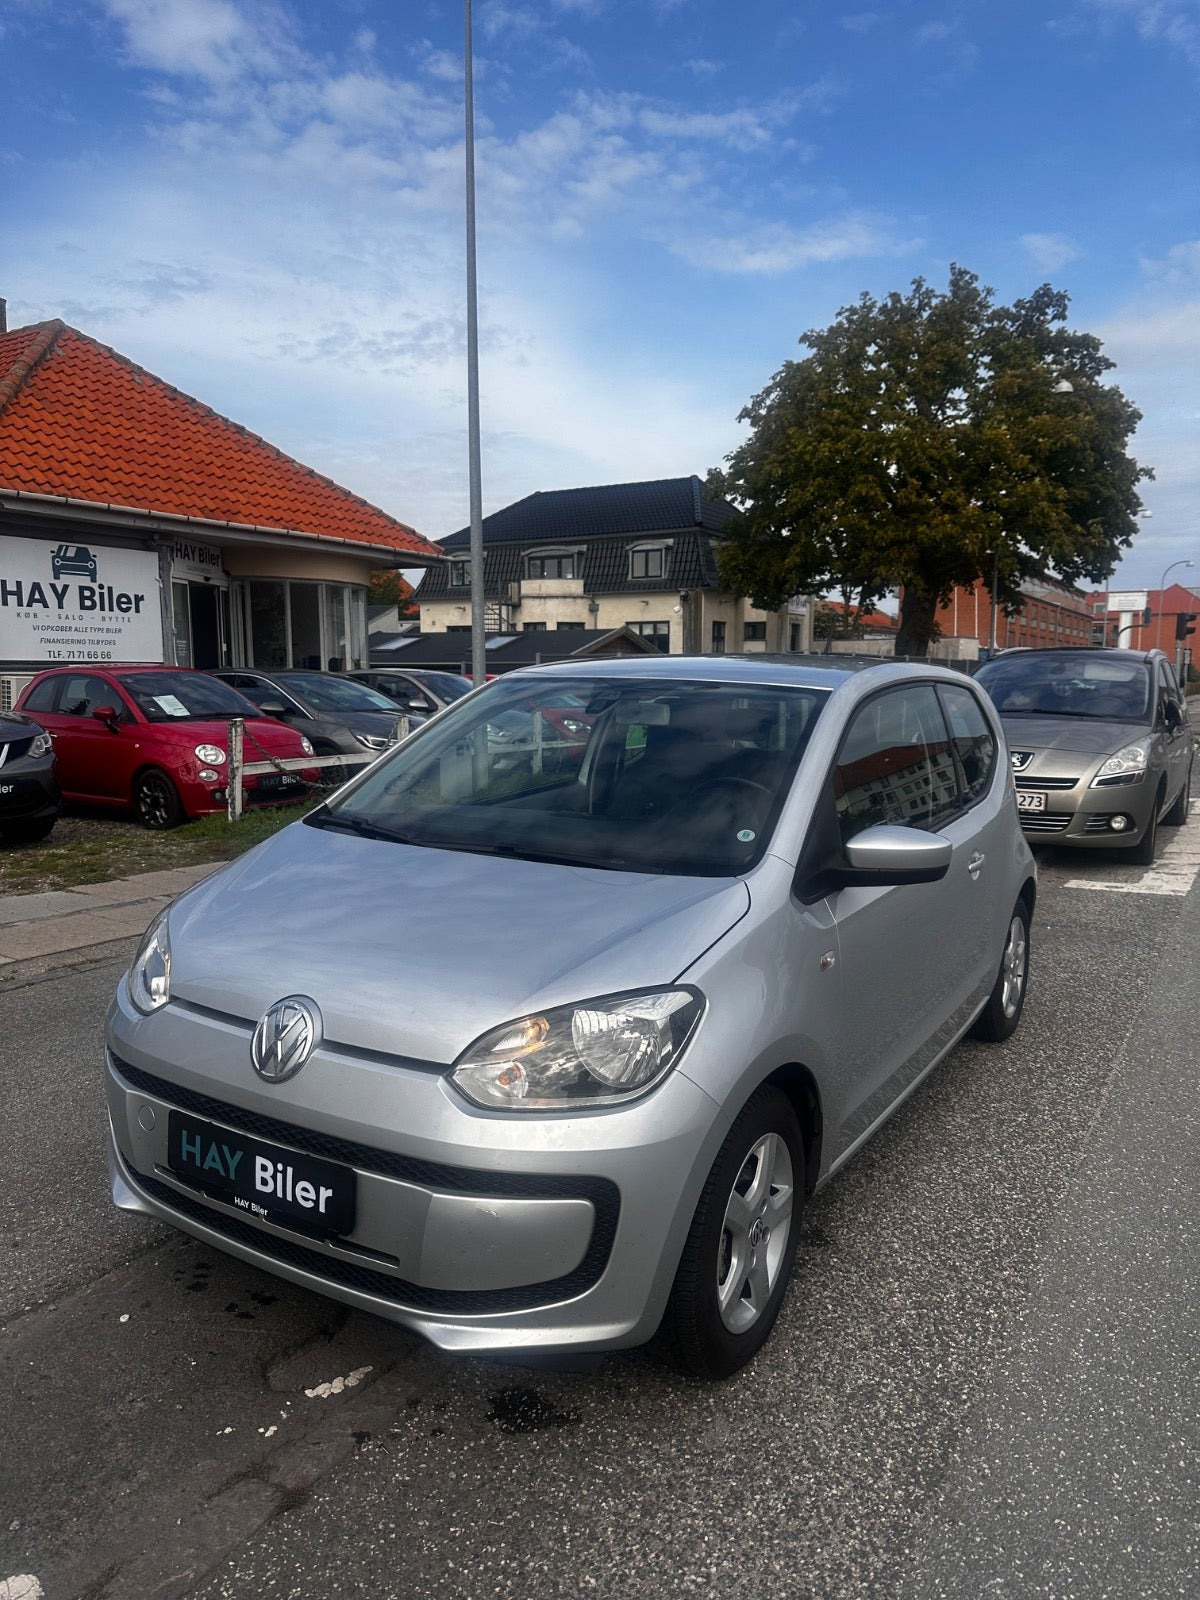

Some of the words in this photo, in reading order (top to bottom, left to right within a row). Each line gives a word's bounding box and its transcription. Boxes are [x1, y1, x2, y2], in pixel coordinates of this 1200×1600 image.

[175, 542, 196, 561] HAY
[198, 547, 220, 567] Biler
[1, 579, 70, 609] HAY
[78, 583, 145, 614] Biler
[101, 615, 132, 623] BYTTE
[32, 624, 40, 632] VI
[40, 637, 87, 645] FINANSIERING
[87, 638, 117, 646] TILBYDES
[47, 650, 65, 659] TLF.
[66, 650, 75, 659] 71
[77, 651, 85, 659] 71
[87, 651, 99, 659] 66
[100, 651, 112, 659] 66
[1018, 795, 1043, 808] 273
[181, 1129, 244, 1181] HAY
[255, 1155, 333, 1214] Biler
[234, 1196, 250, 1209] HAY
[251, 1202, 269, 1216] Biler
